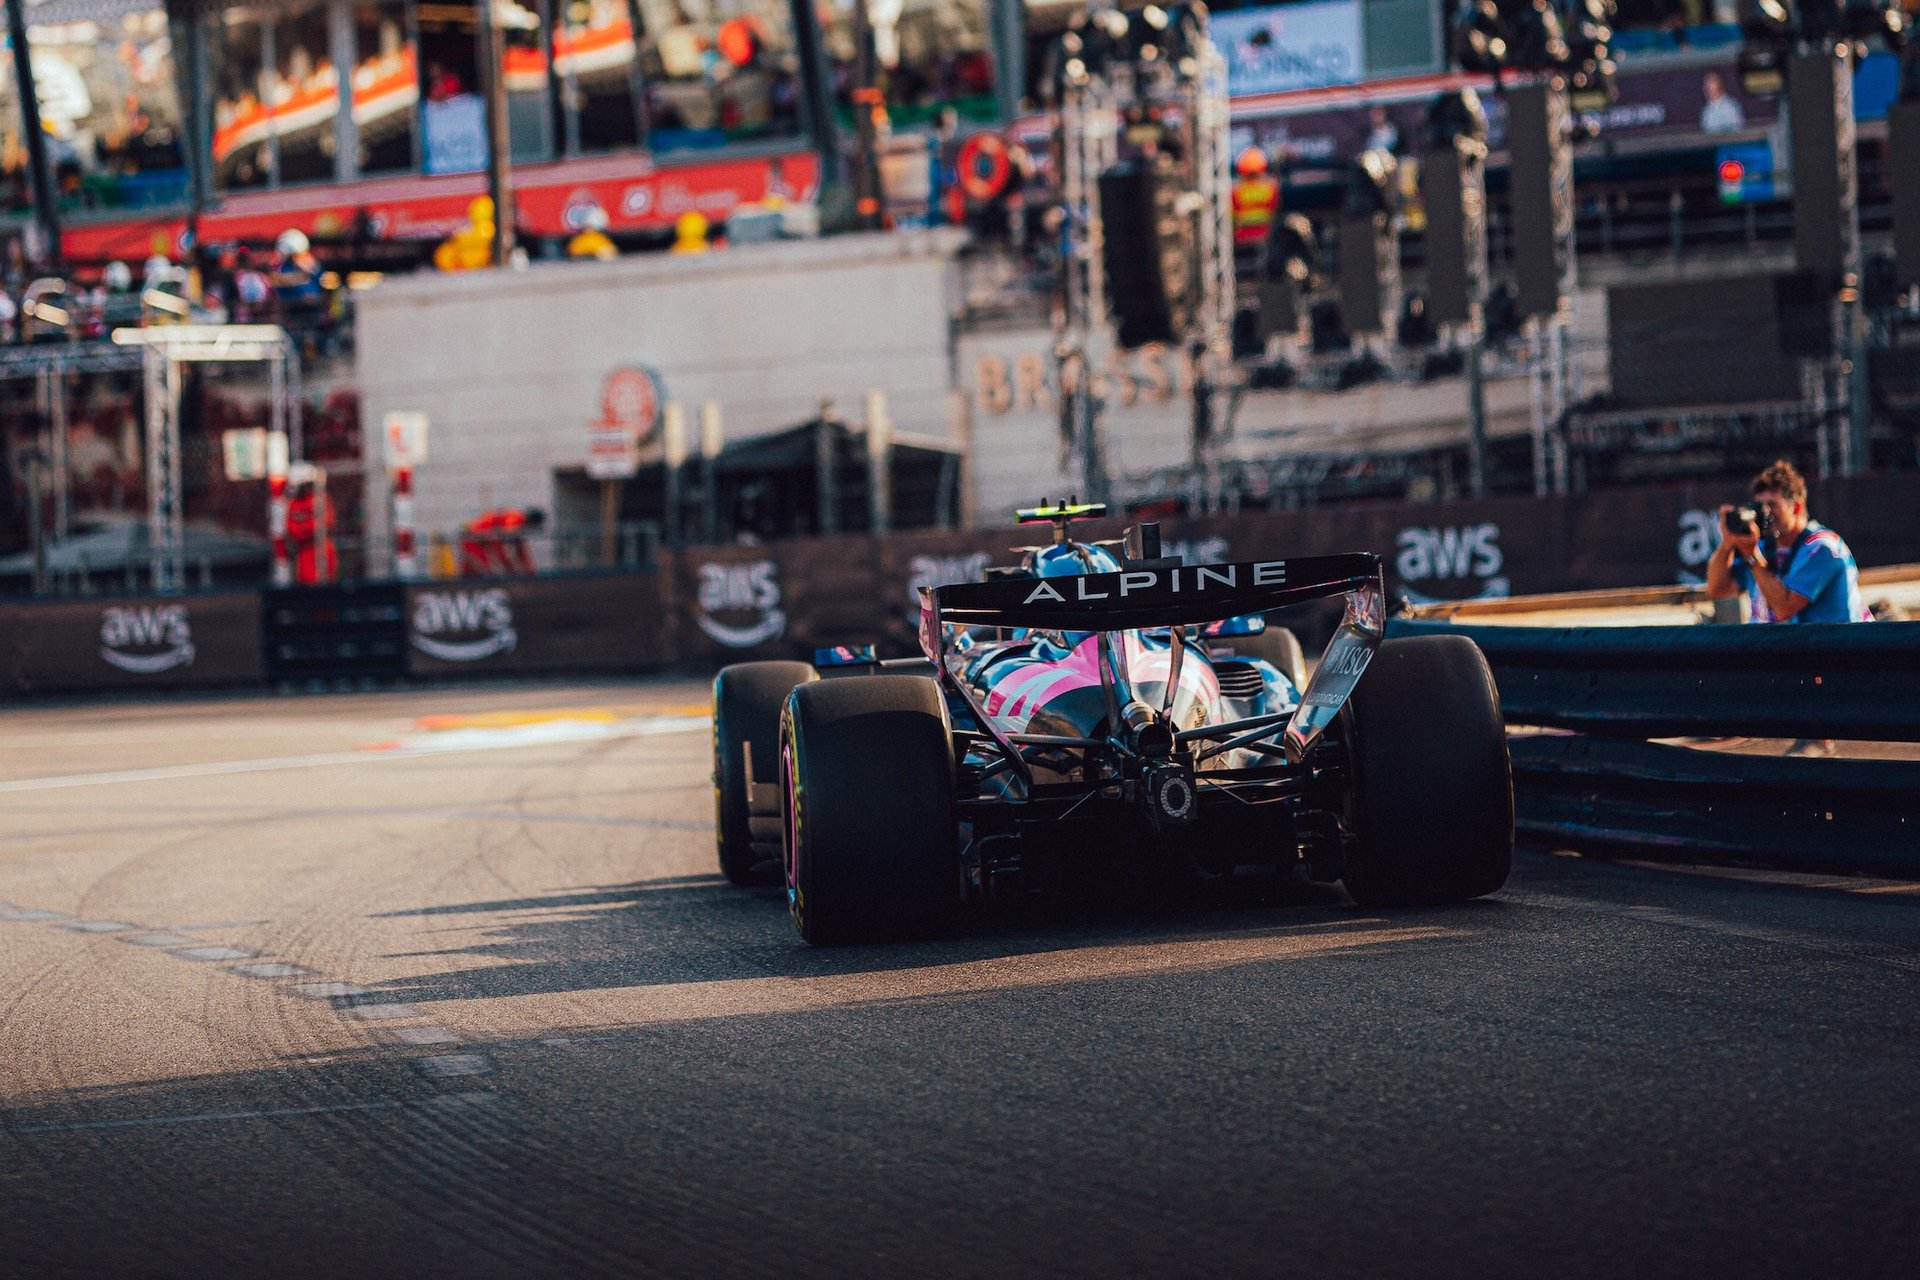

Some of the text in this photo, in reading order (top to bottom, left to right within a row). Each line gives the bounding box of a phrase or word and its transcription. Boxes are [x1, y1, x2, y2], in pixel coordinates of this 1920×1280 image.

[1397, 521, 1503, 582] aws
[699, 561, 780, 610] aws
[1022, 561, 1287, 604] ALPINE
[101, 605, 191, 646] aws
[414, 589, 512, 633] aws
[1332, 646, 1371, 676] MSC
